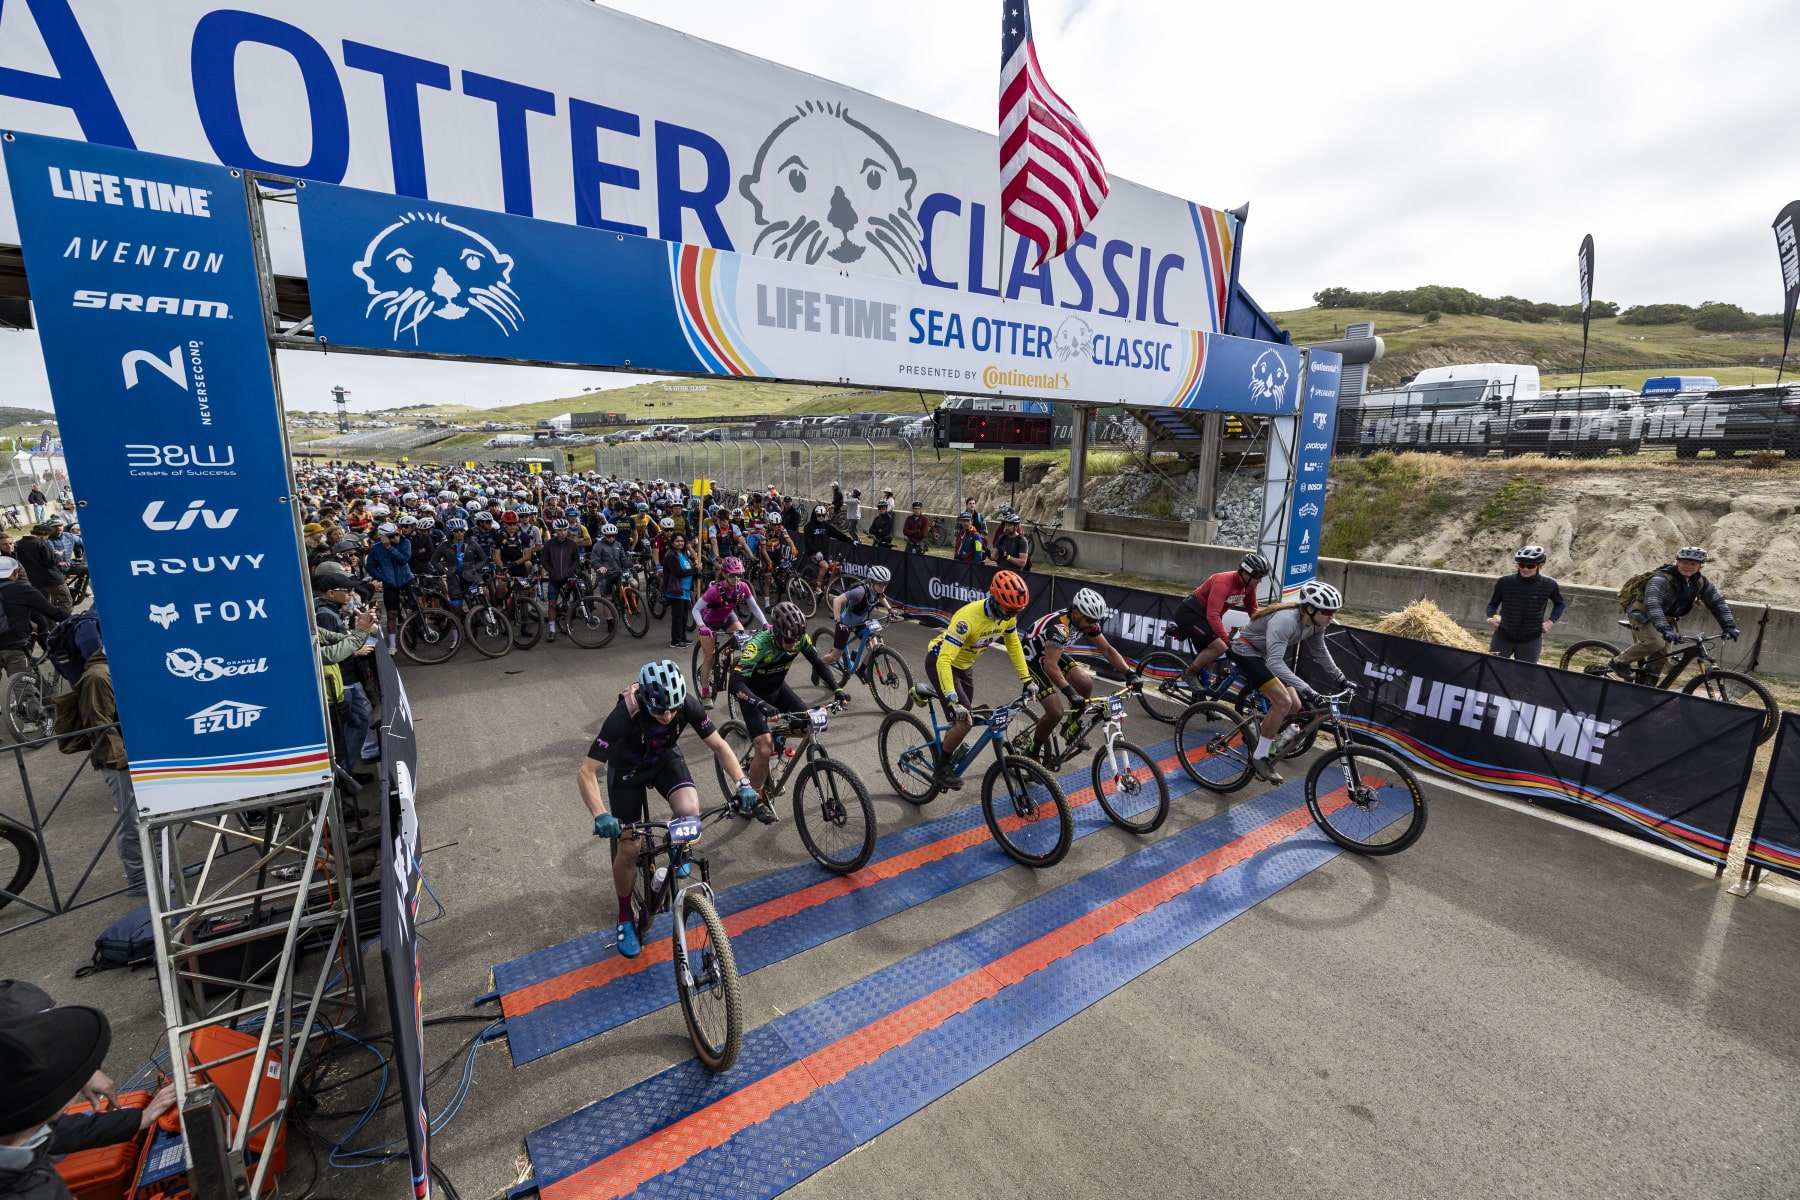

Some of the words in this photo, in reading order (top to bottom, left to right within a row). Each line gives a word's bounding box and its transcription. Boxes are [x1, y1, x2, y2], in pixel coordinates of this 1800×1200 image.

[191, 9, 735, 252] OTTER
[48, 166, 124, 206] LIFE
[124, 177, 211, 218] TIME
[1776, 215, 1796, 256] LIFE
[63, 236, 224, 273] AVENTON
[917, 193, 1185, 326] CLASSIC
[1782, 245, 1799, 292] TIME
[72, 289, 229, 319] SRAM
[757, 284, 821, 332] LIFE
[825, 294, 897, 341] TIME
[909, 307, 965, 349] SEA
[971, 316, 1052, 360] OTTER
[1092, 334, 1172, 372] CLASSIC
[189, 340, 212, 425] NEVERSECOND
[899, 365, 961, 379] PRESENTED
[965, 371, 977, 380] BY
[982, 365, 1060, 390] Continental
[1313, 412, 1327, 424] FOX
[1408, 411, 1488, 443] TIME
[1307, 483, 1322, 491] BOSCH
[142, 500, 239, 531] Liv
[130, 554, 265, 576] ROUVY
[193, 599, 268, 624] FOX
[1121, 613, 1167, 648] LIFE
[193, 657, 268, 681] Seal
[1405, 676, 1488, 730] LIFE
[1491, 694, 1611, 764] TIME
[675, 825, 698, 836] 434
